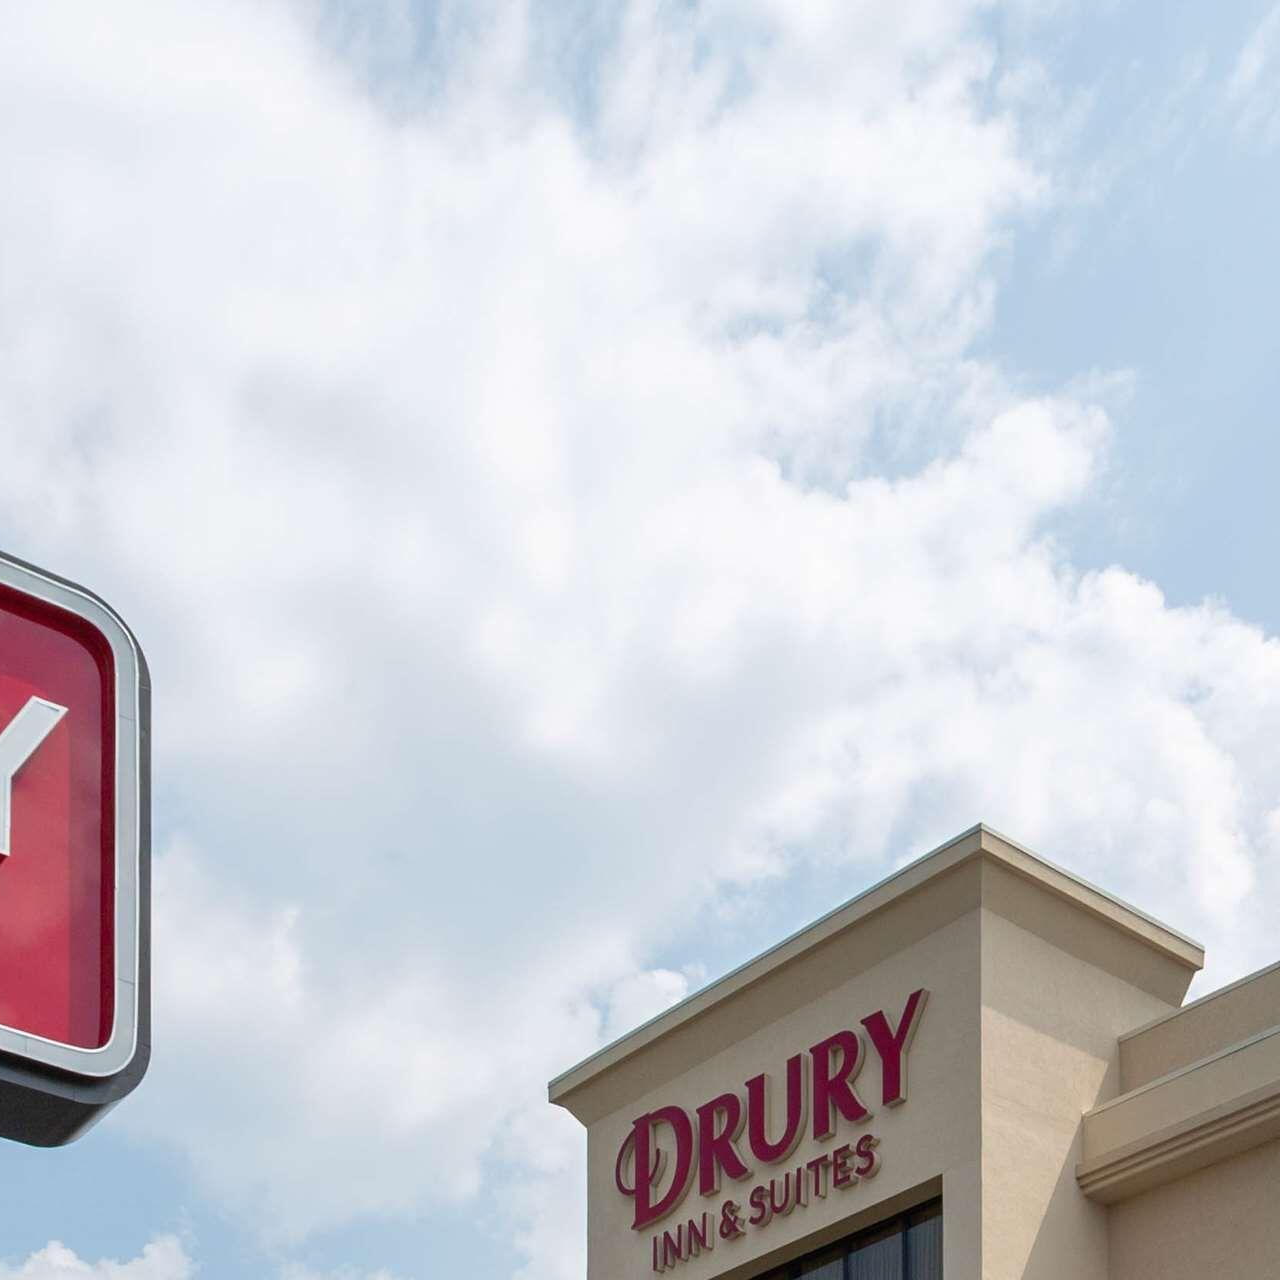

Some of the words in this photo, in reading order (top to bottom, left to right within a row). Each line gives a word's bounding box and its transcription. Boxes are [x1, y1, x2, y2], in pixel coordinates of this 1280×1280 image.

[615, 987, 927, 1230] DRURY
[652, 1211, 711, 1273] INN
[719, 1200, 743, 1241] &
[749, 1134, 879, 1227] SUITES
